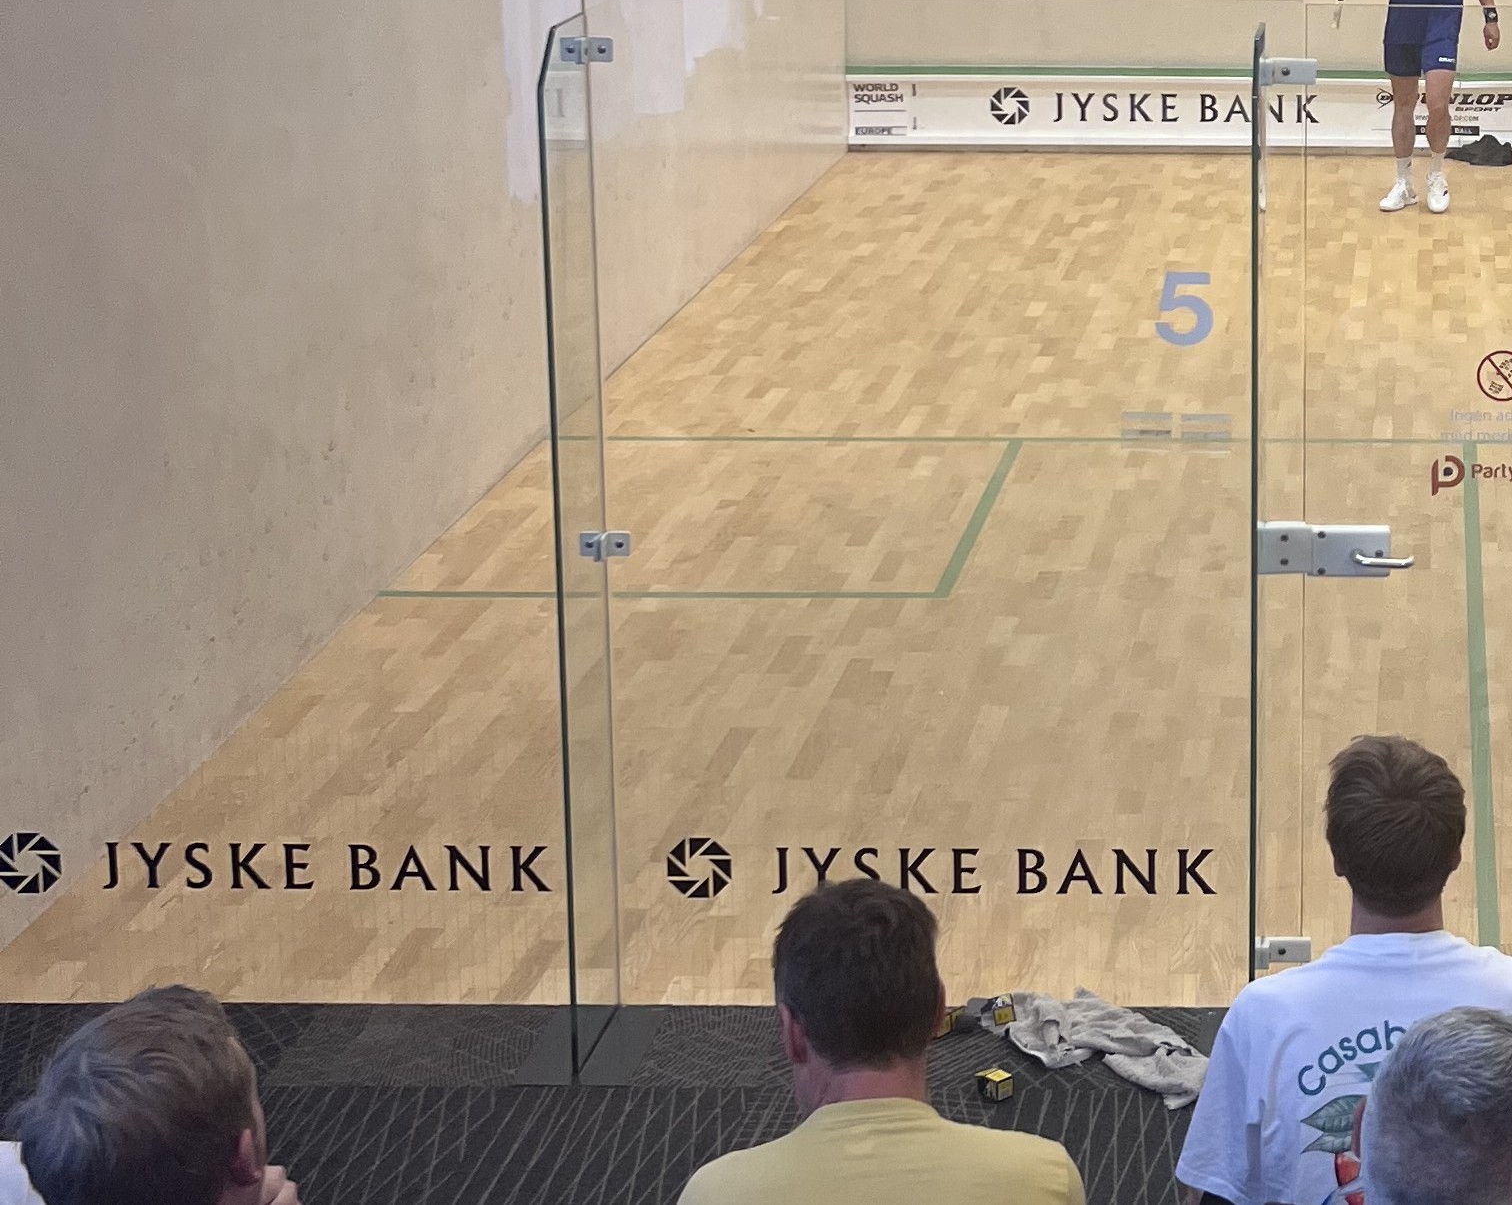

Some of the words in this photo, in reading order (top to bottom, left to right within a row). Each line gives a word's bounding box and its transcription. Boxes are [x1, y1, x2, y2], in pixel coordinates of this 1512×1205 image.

[853, 82, 899, 92] WORLD
[854, 93, 904, 105] SQUASH
[1053, 92, 1180, 123] JYSKE
[1200, 93, 1320, 124] BANK
[1155, 270, 1214, 347] 5
[102, 842, 314, 891] JYSKE
[348, 843, 552, 892] BANK
[772, 847, 982, 895] JYSKE
[1016, 847, 1217, 895] BANK
